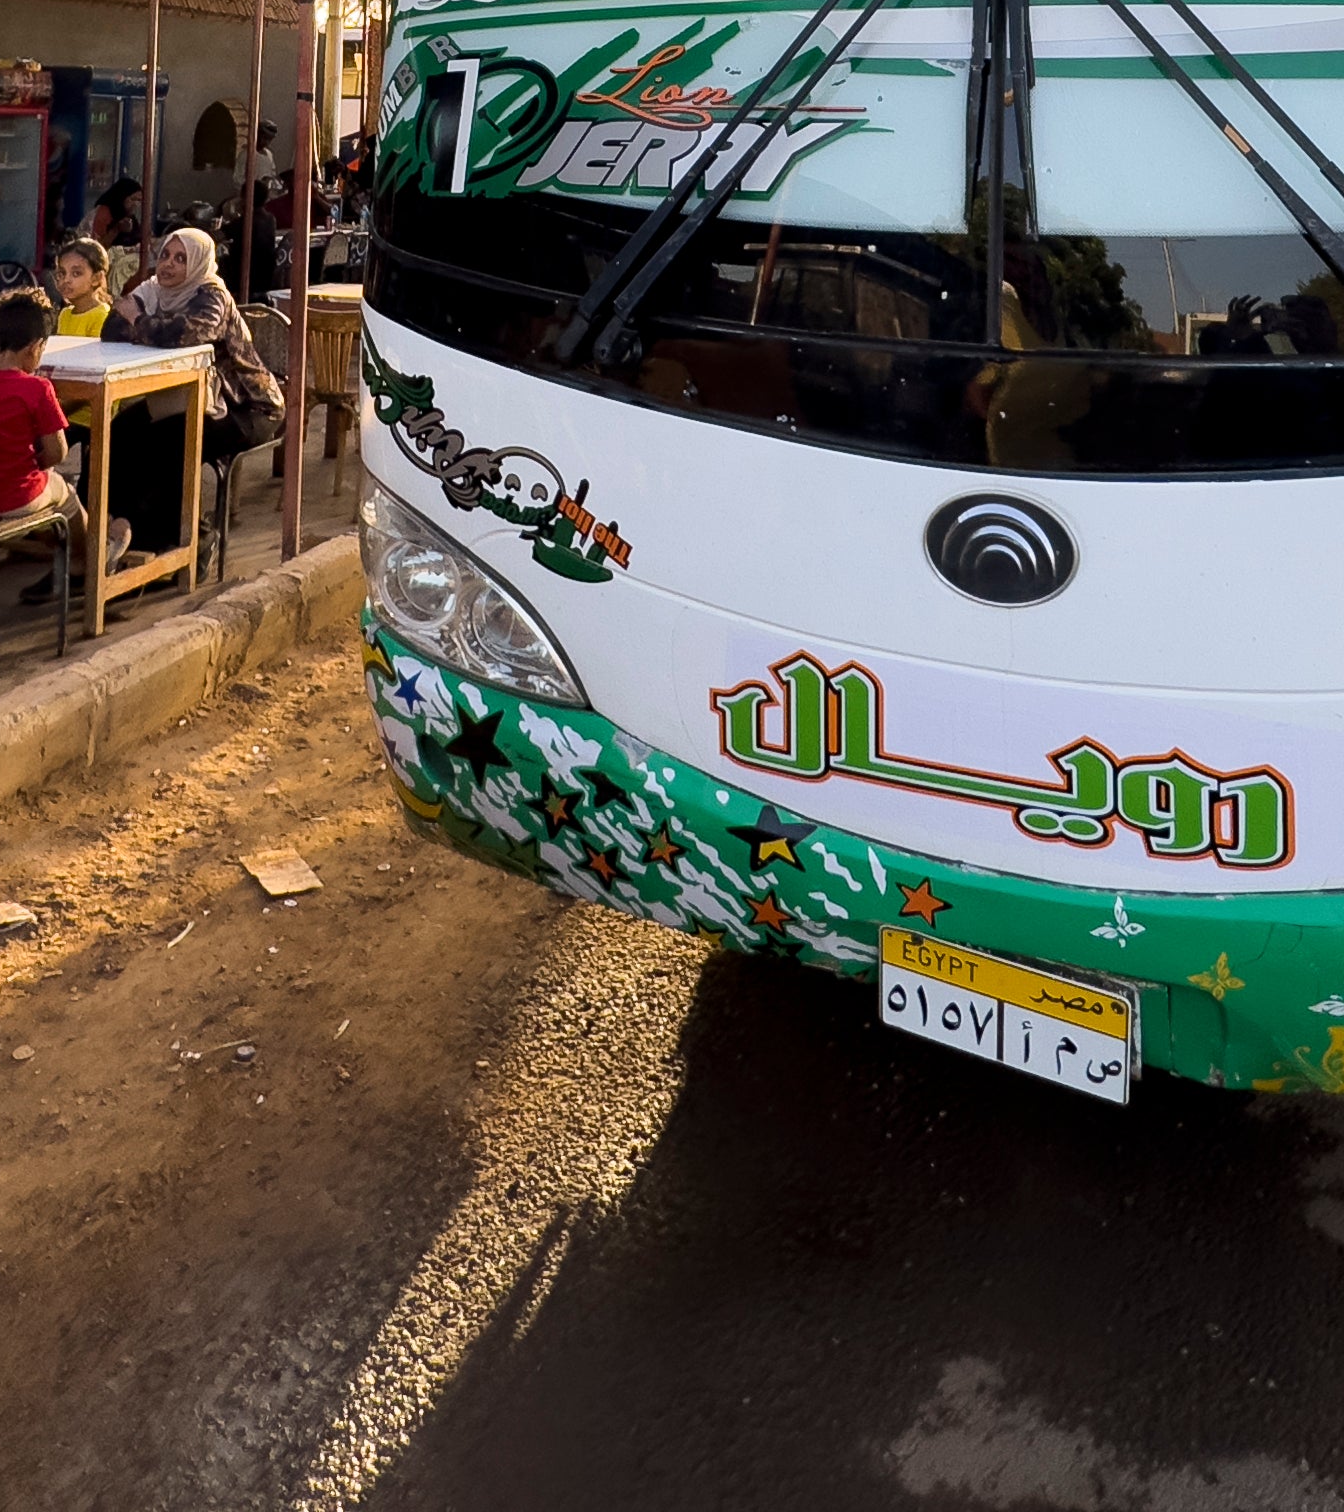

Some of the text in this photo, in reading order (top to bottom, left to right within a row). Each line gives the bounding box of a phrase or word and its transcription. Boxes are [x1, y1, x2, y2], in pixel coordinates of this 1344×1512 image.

[575, 44, 806, 131] Lion
[710, 649, 1295, 871] رويال
[902, 939, 979, 983] EGYPT
[1029, 987, 1104, 1016] مصر
